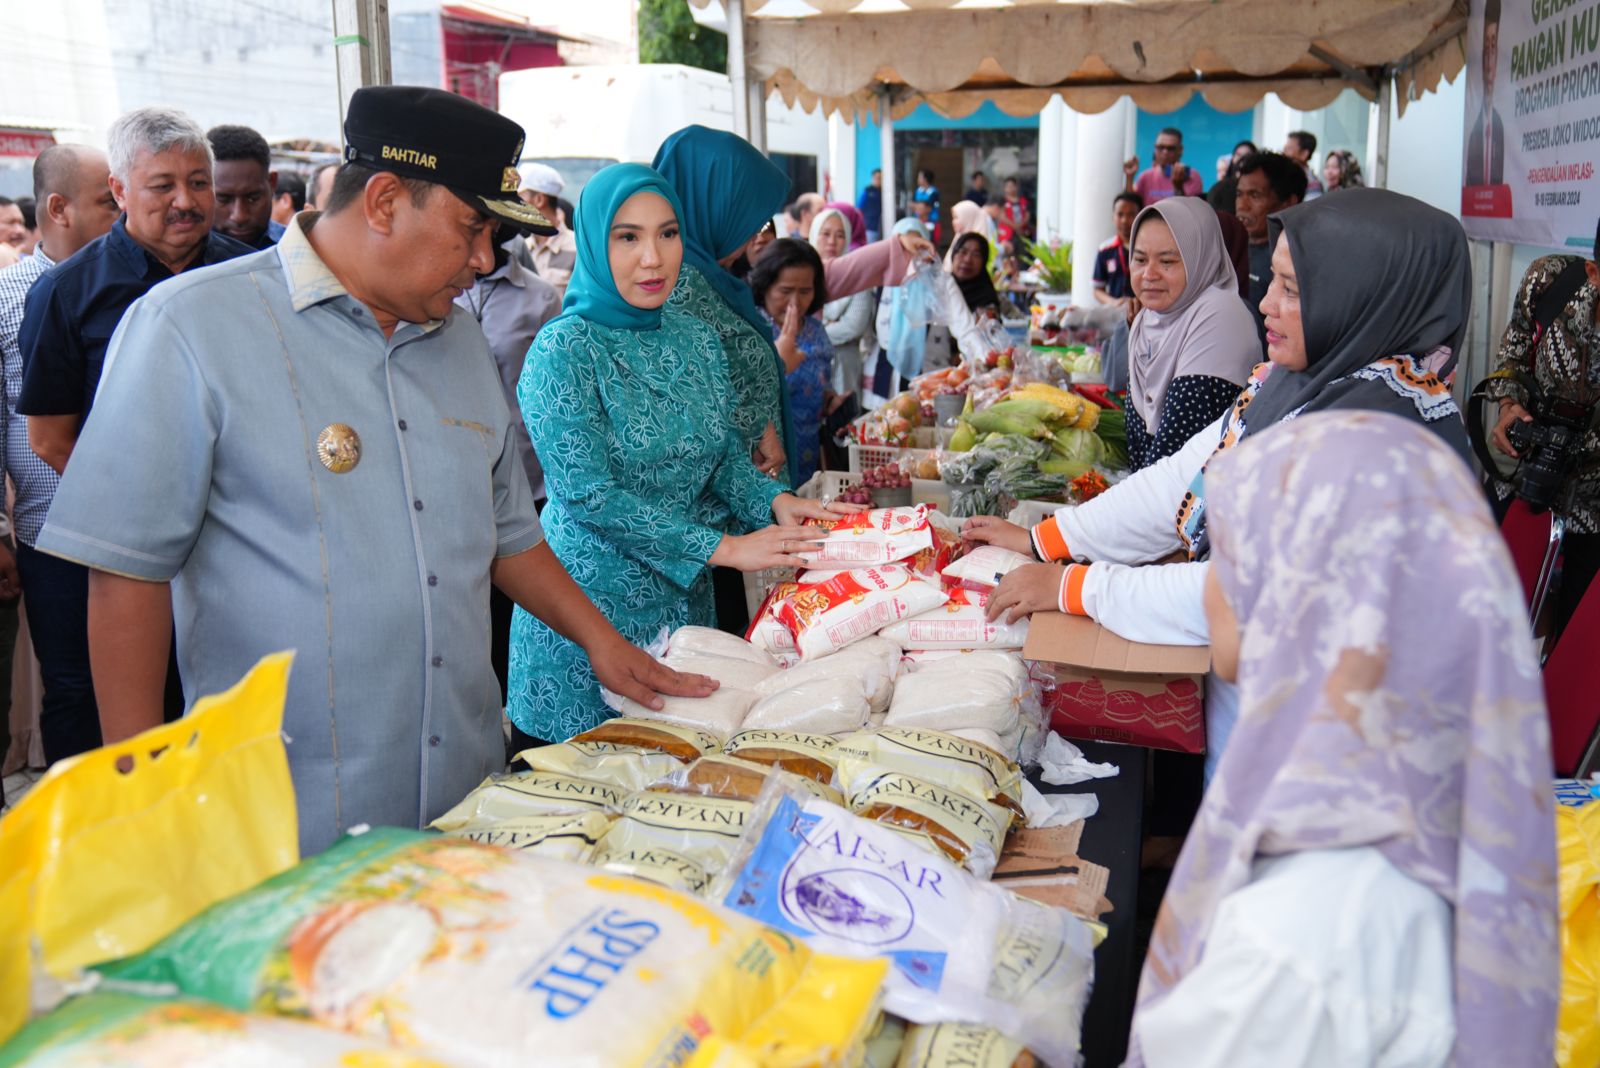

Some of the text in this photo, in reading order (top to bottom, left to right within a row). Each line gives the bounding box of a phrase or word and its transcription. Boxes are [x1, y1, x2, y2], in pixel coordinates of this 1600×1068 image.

[1511, 20, 1566, 83] PANGAN
[1515, 74, 1560, 118] PROGRAM
[382, 145, 437, 169] BAHTIAR
[1522, 127, 1550, 152] PRESIDEN
[1551, 123, 1571, 147] JOKO
[1567, 189, 1580, 205] 2024
[863, 566, 889, 590] mpas
[898, 729, 994, 768] MINYAK
[787, 815, 947, 899] KAISAR
[526, 907, 661, 1020] SPHP
